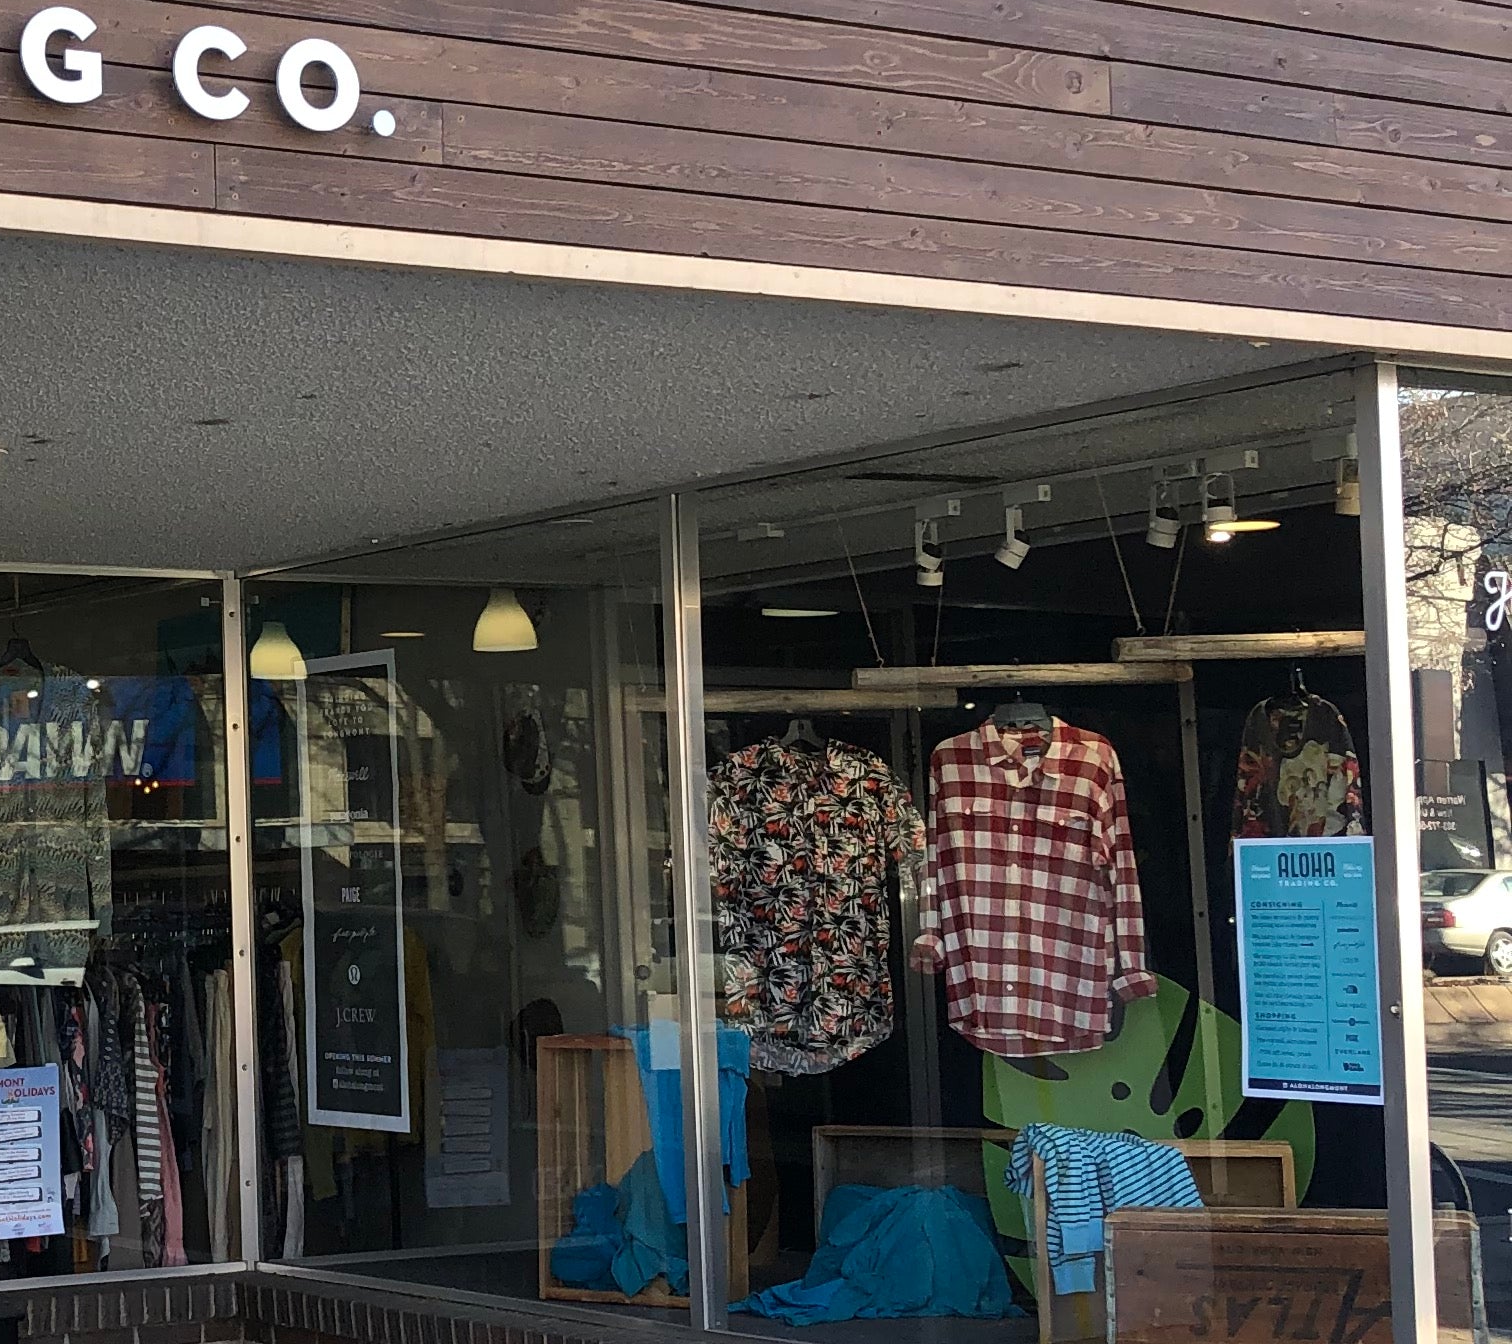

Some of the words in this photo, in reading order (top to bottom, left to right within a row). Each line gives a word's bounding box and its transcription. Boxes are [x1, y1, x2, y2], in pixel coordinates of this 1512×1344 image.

[172, 25, 397, 137] CO.
[1277, 851, 1336, 878] ALOHA
[1278, 879, 1321, 887] TRADING
[341, 886, 361, 903] PAIGE
[1250, 900, 1303, 908] CONSIGNING
[335, 1007, 376, 1028] J.CREW
[1254, 1011, 1297, 1020] SHOPPING
